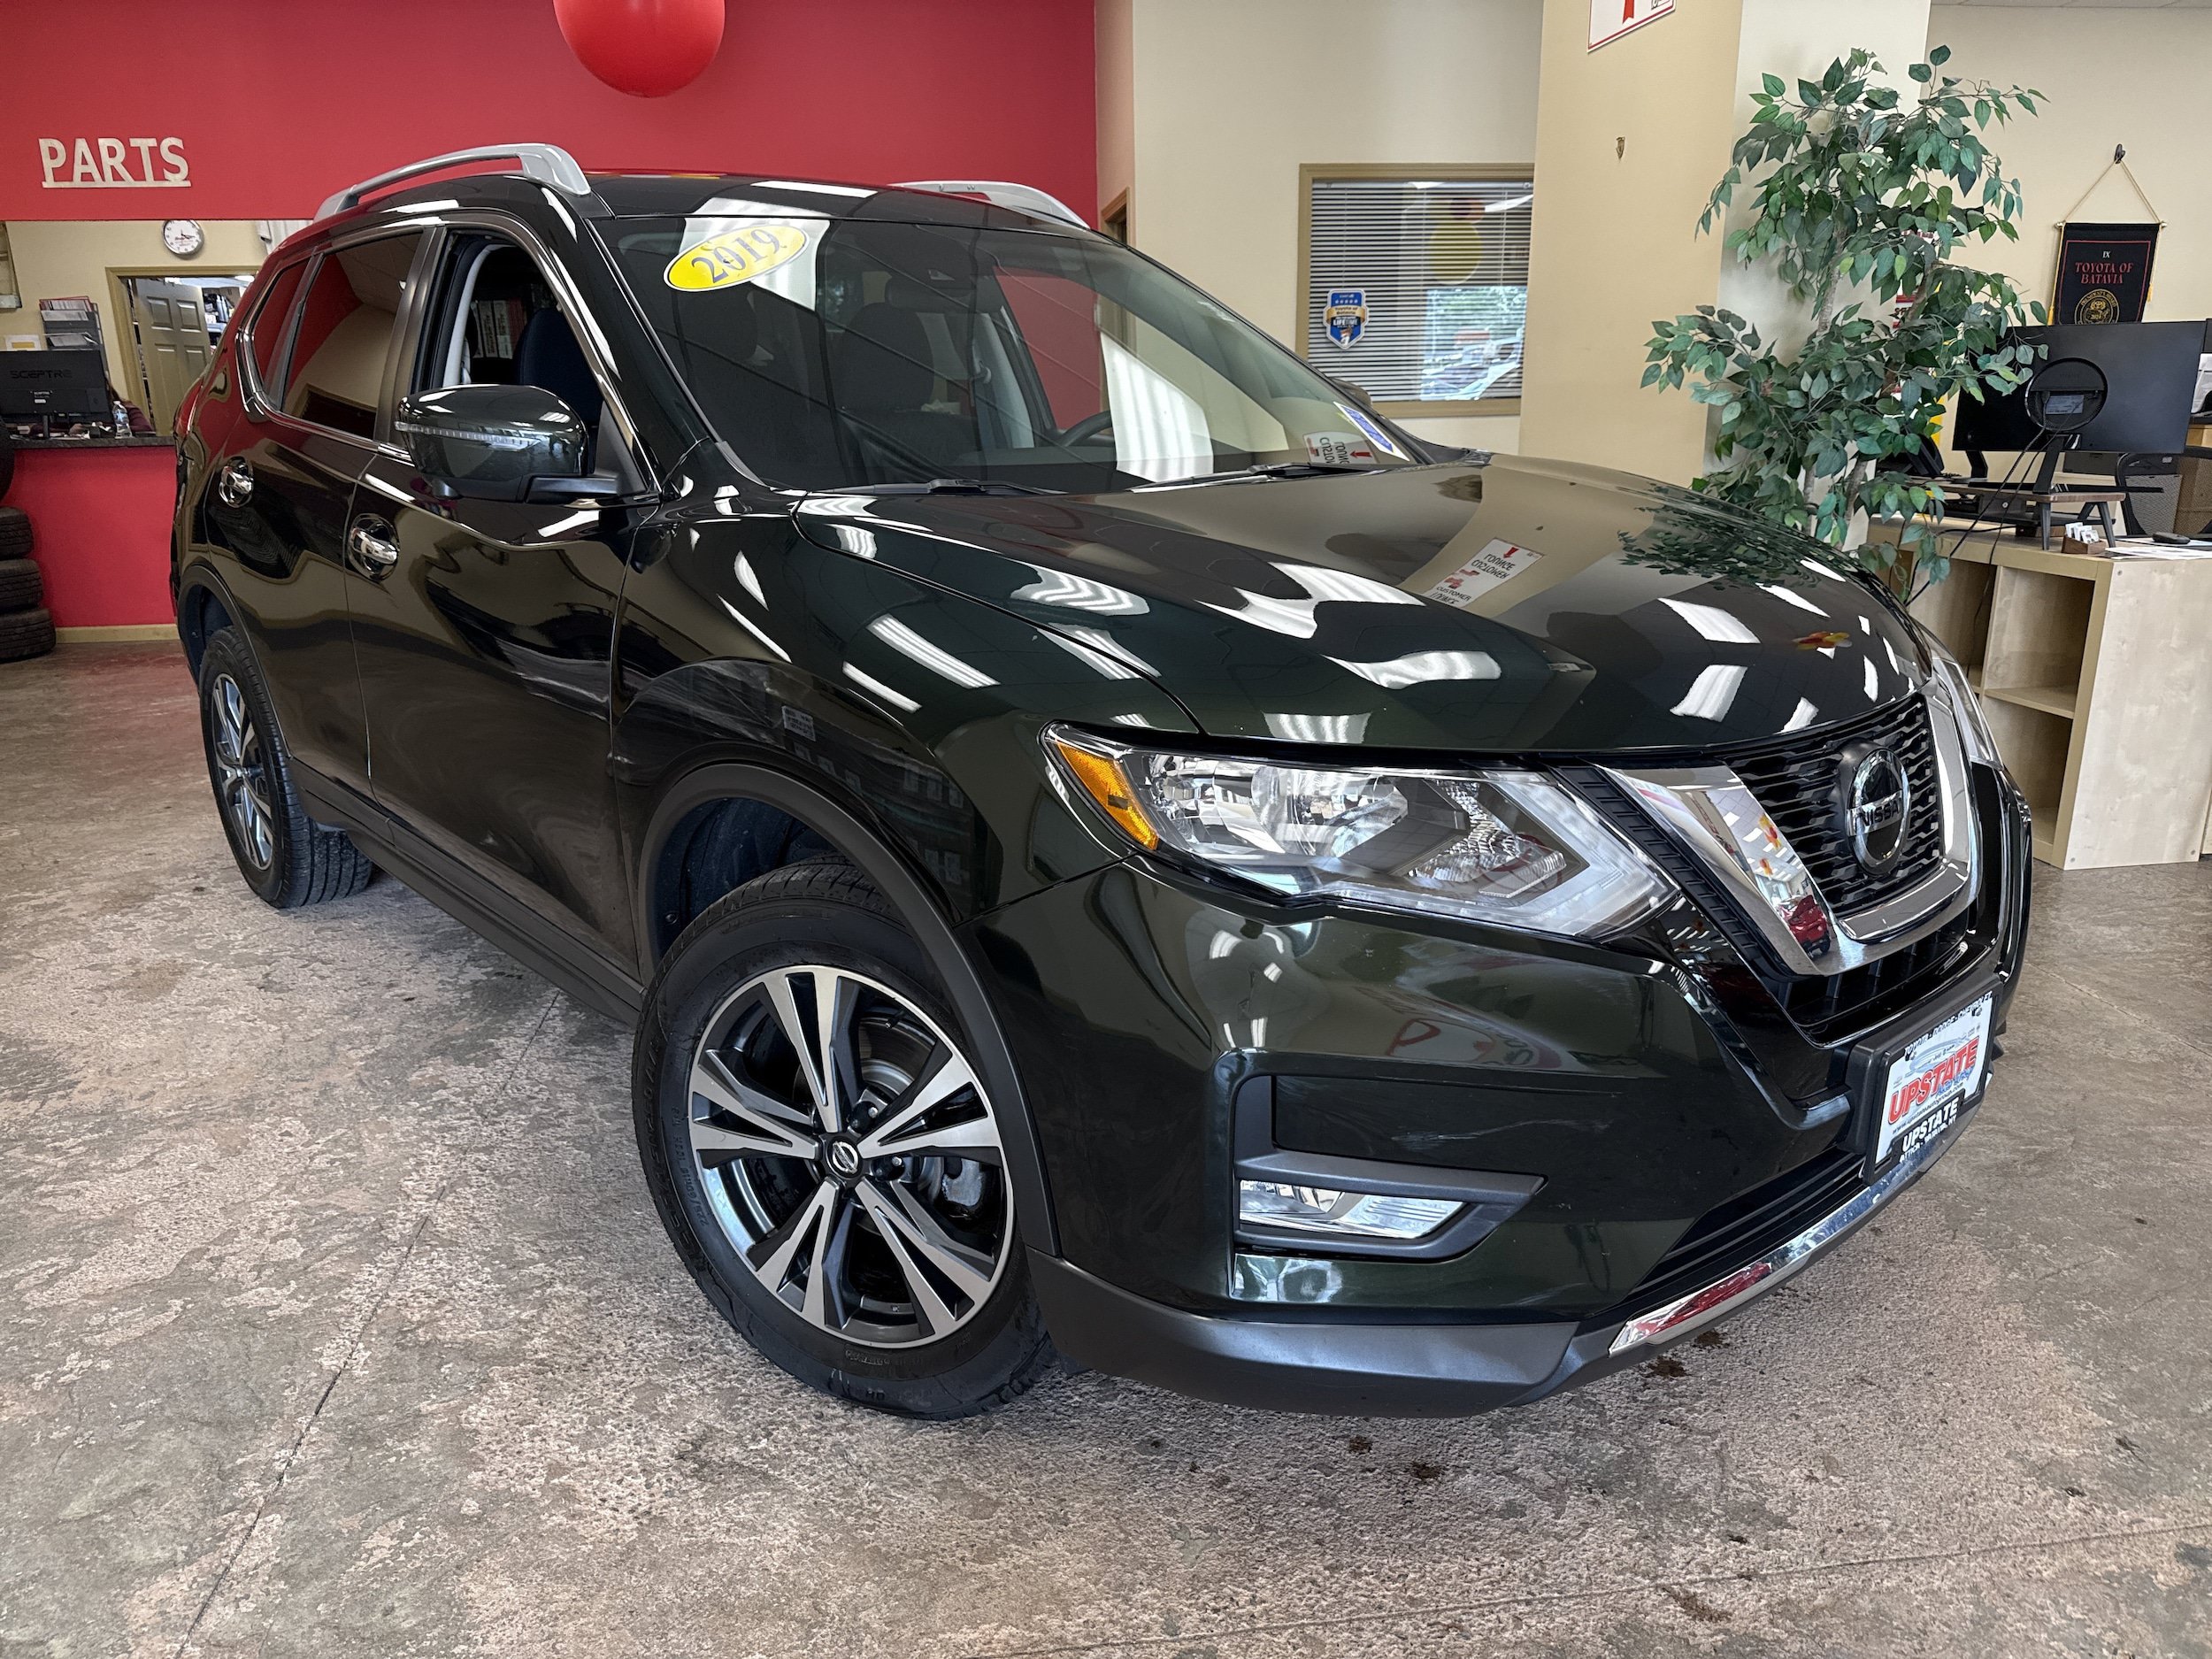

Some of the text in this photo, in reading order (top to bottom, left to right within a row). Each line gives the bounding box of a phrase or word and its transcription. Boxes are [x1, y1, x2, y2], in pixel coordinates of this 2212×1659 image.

[38, 136, 189, 187] PARTS
[691, 228, 780, 283] 2019
[2075, 262, 2134, 273] TOYOTA OF
[2080, 273, 2124, 283] BATAVIA
[10, 370, 73, 380] SCEPTRE
[1855, 797, 1902, 826] NISSA
[1888, 1035, 1980, 1125] UPSTATE
[1901, 1096, 1960, 1153] UPSTATE
